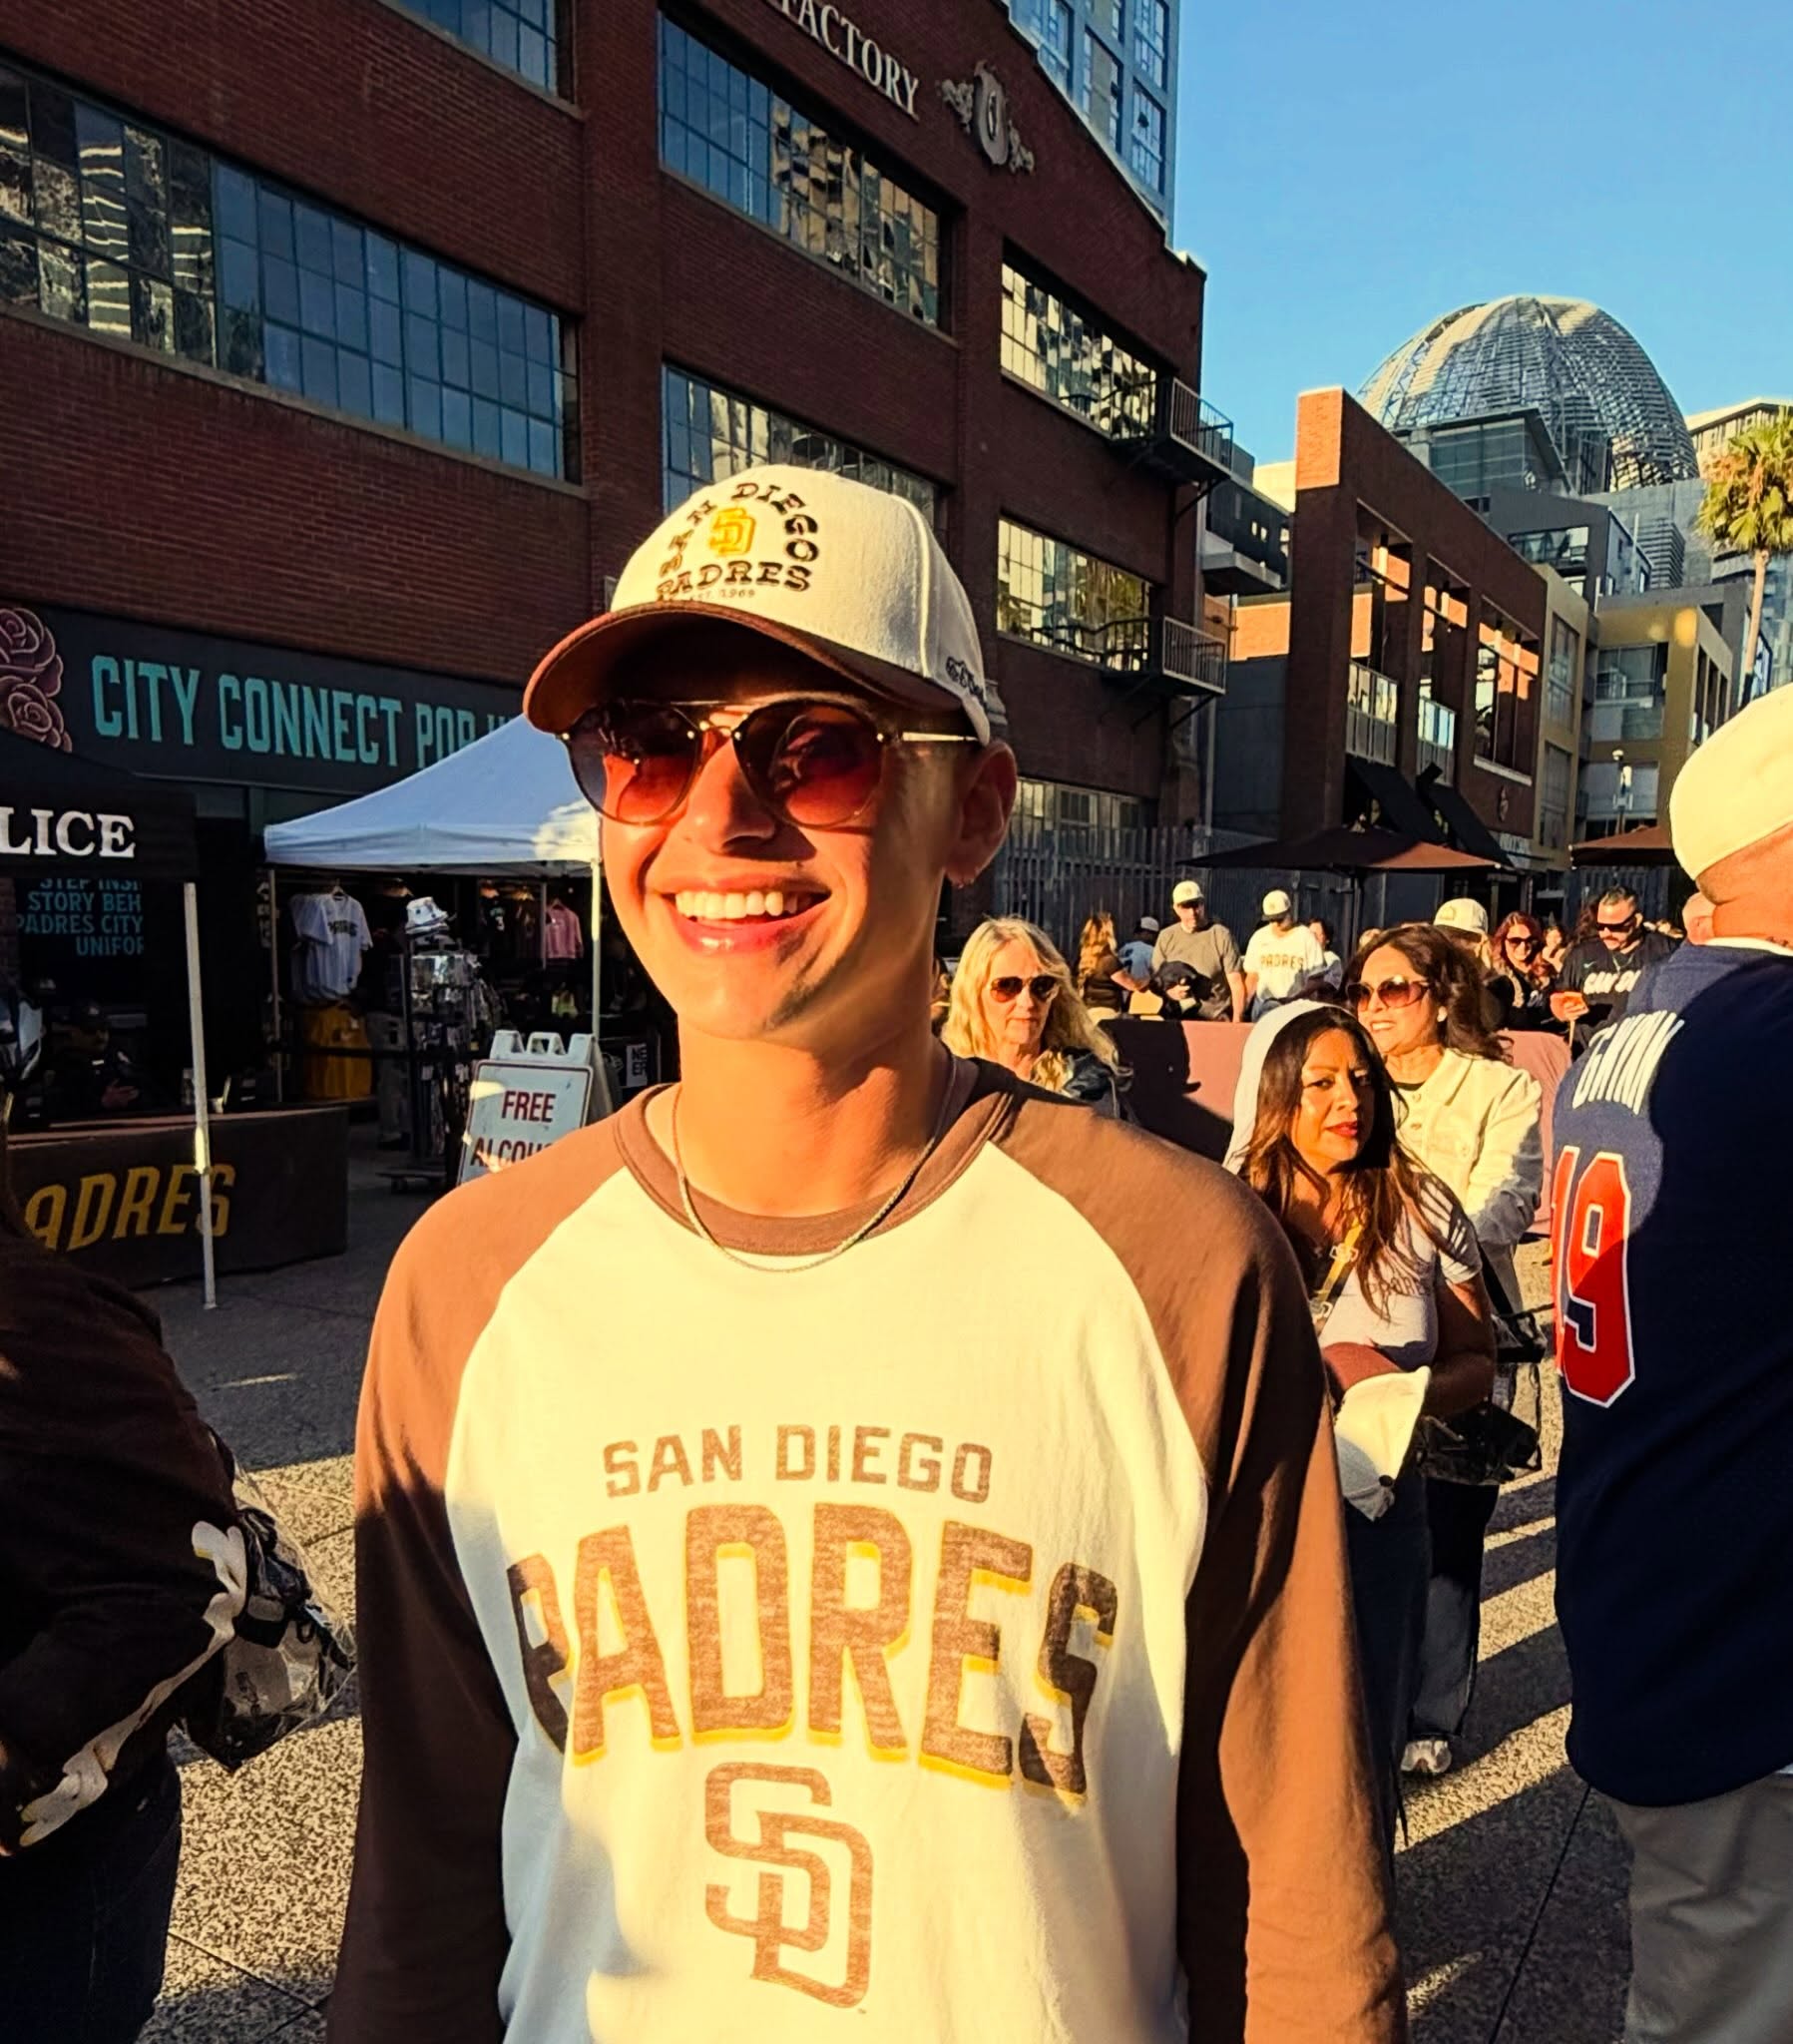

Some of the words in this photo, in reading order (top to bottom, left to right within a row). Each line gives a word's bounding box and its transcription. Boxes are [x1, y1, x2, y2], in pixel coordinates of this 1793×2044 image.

[730, 482, 820, 563] DIEGO
[657, 559, 812, 602] PADRES
[92, 656, 199, 746] CITY
[219, 675, 402, 766] CONNECT
[27, 891, 95, 912] STORY
[101, 913, 144, 934] CITY
[502, 1089, 556, 1123] FREE
[470, 1137, 552, 1168] ALCO
[1551, 1145, 1635, 1408] 19
[603, 1424, 741, 1497] SAN
[776, 1423, 992, 1503] DIEGO
[507, 1502, 1119, 1814] PADRES
[704, 1762, 873, 2008] SD
